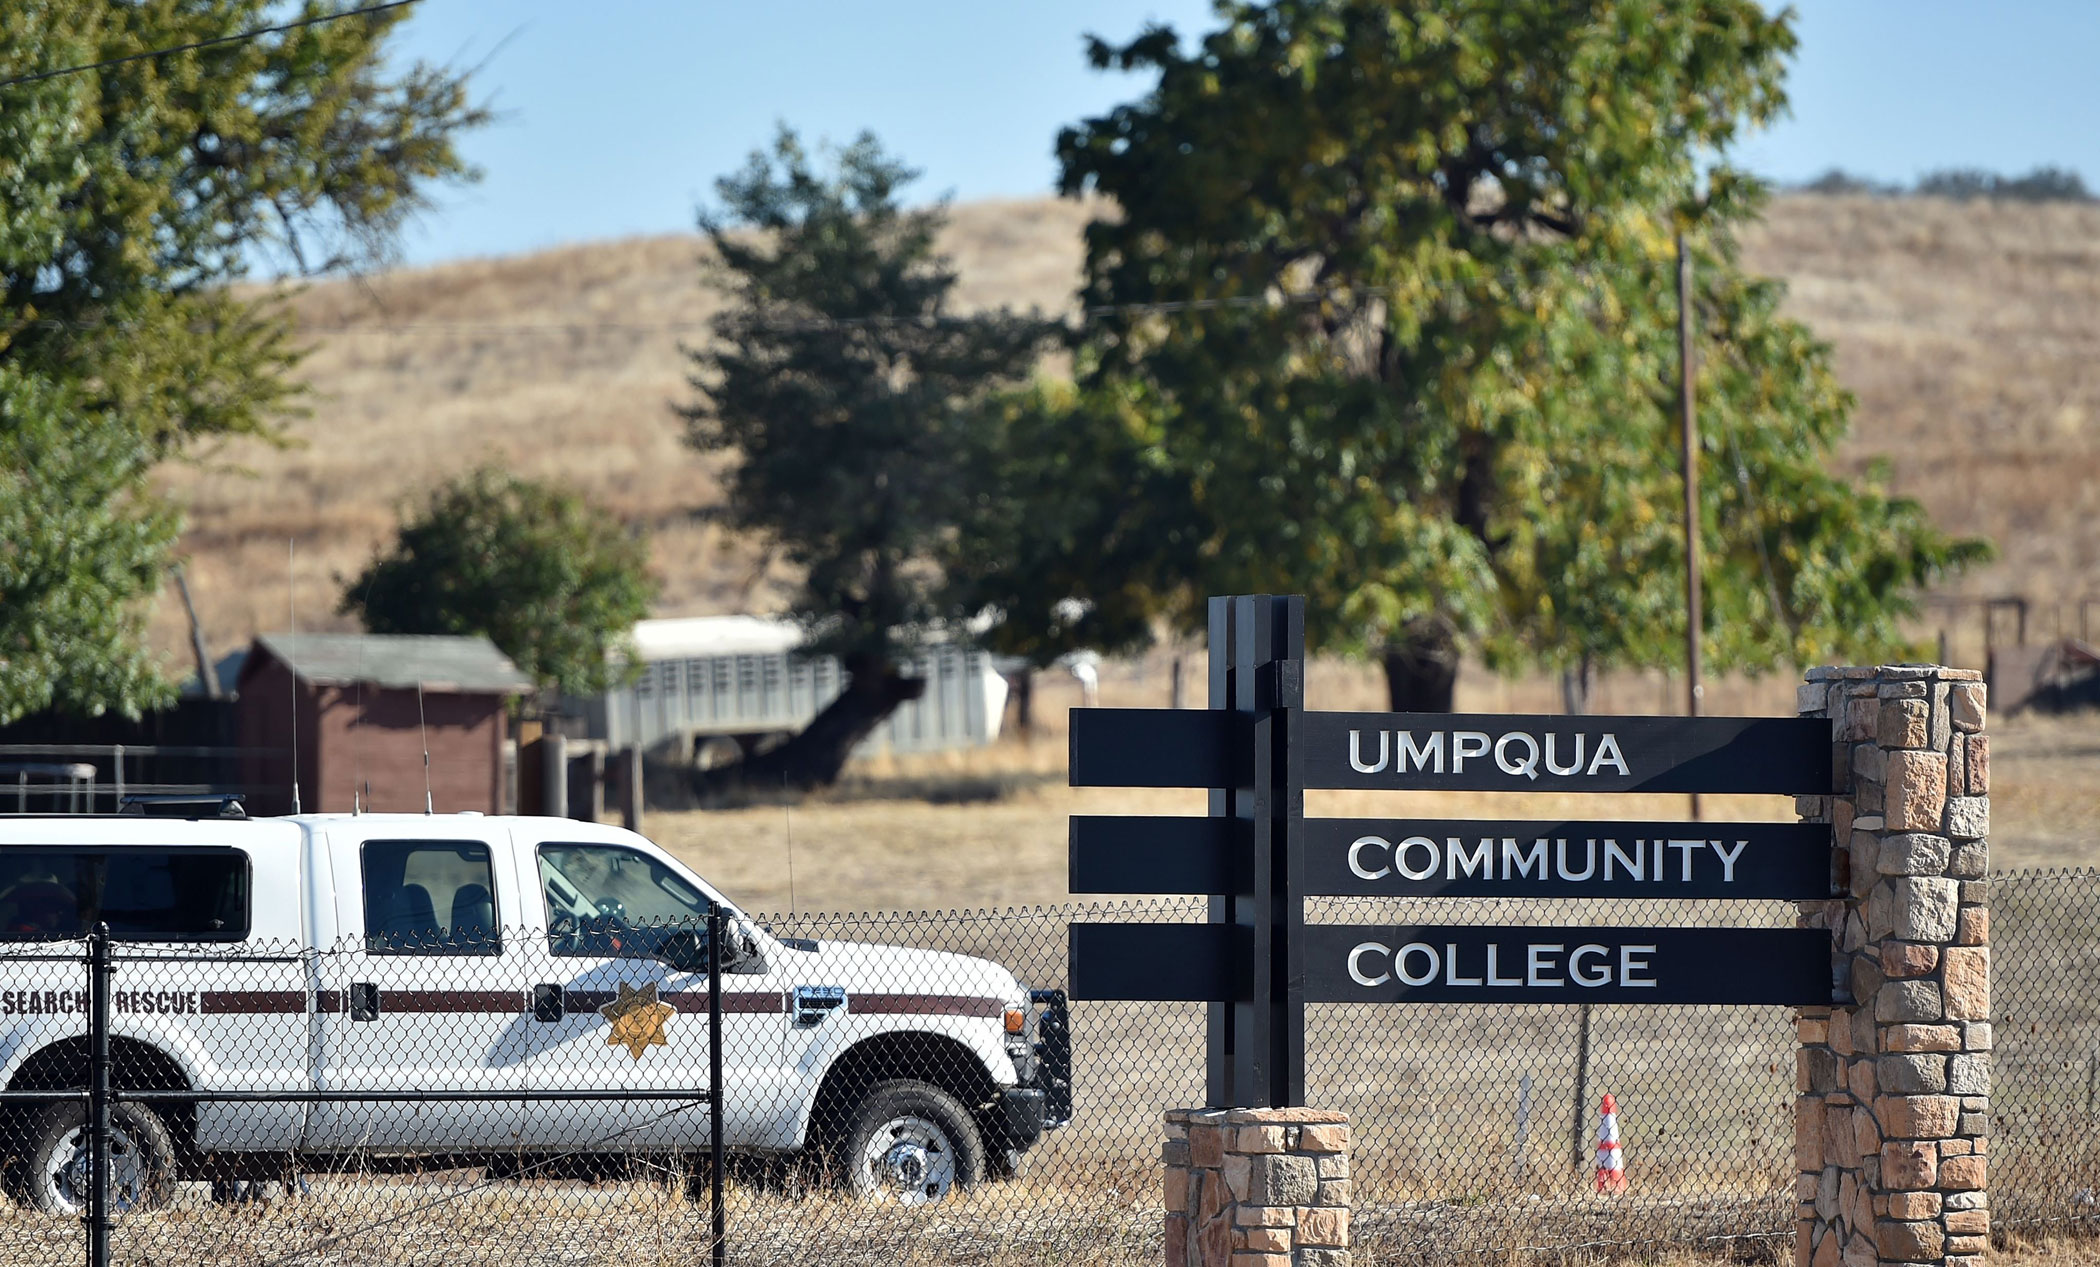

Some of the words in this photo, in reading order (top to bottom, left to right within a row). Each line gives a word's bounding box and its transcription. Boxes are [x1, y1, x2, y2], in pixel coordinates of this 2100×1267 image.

[1348, 729, 1631, 781] UMPQUA
[1347, 835, 1749, 882] COMMUNITY
[1347, 941, 1657, 988] COLLEGE
[2, 990, 89, 1014] SEARCH
[116, 991, 197, 1014] RESCUE
